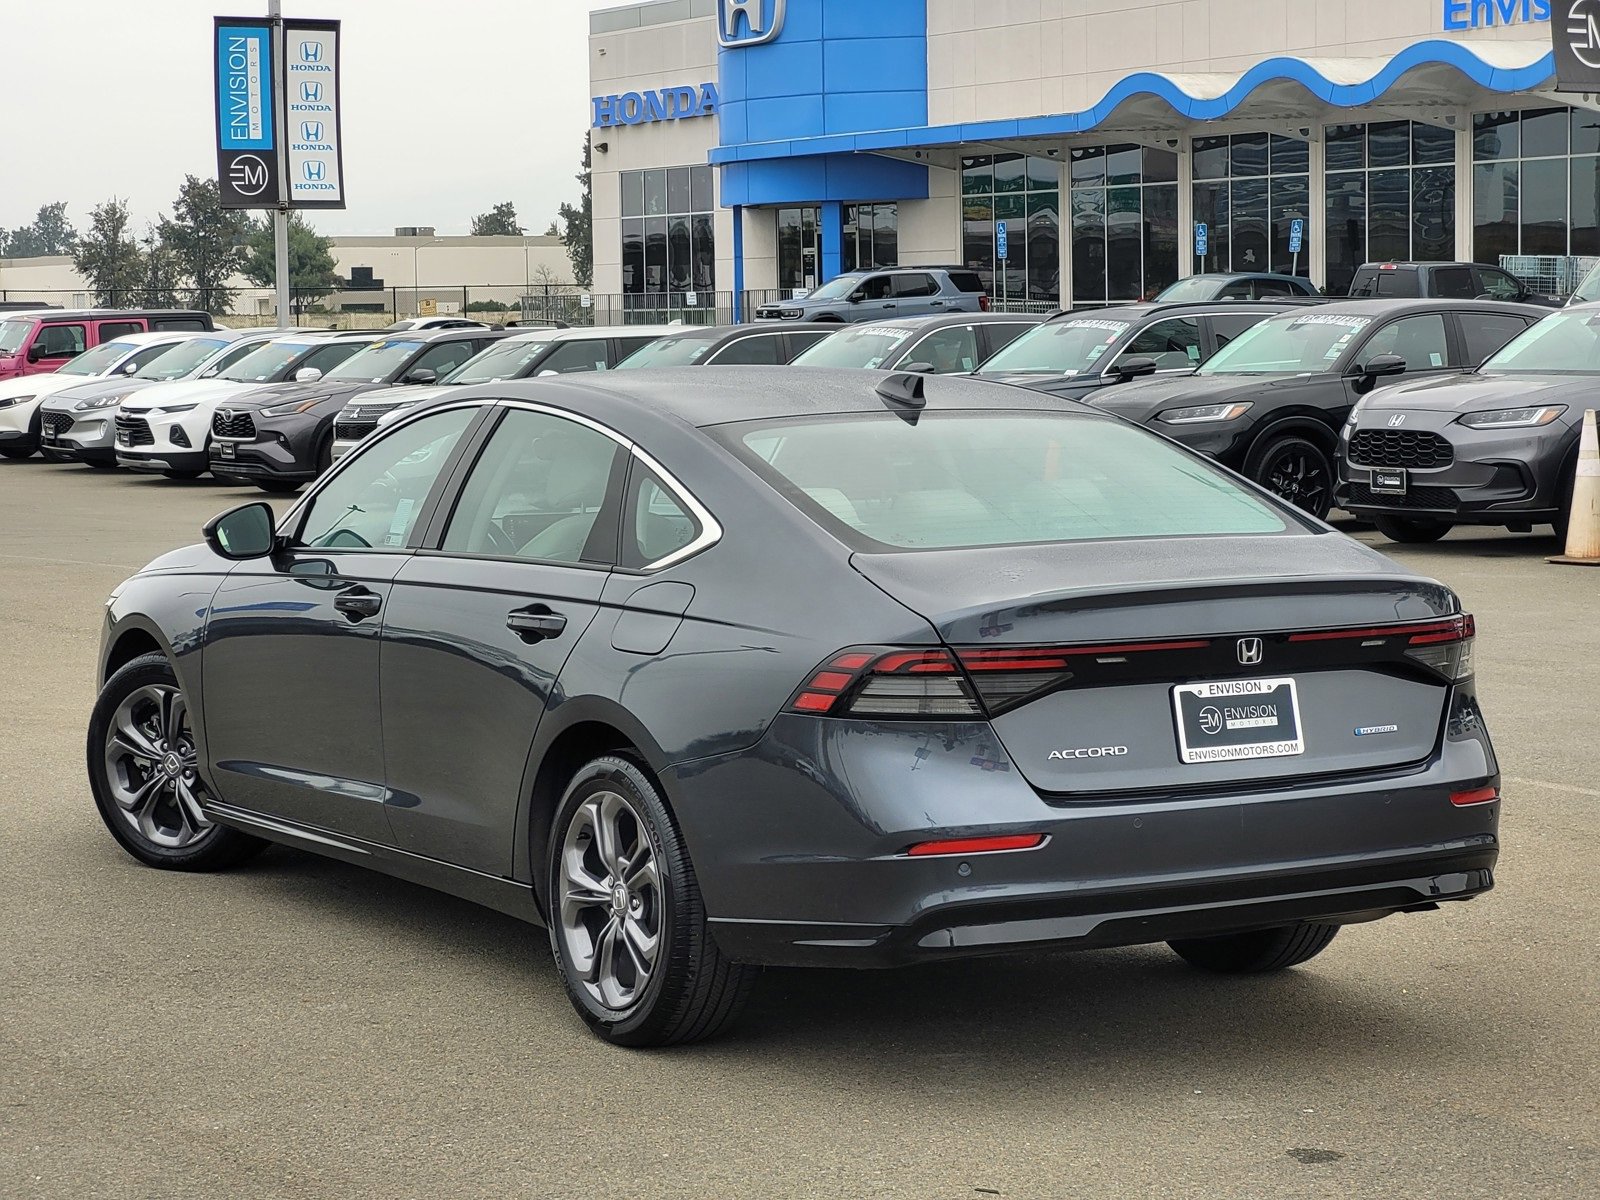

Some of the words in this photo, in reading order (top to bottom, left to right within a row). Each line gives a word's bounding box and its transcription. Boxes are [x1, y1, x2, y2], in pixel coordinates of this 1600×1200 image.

[290, 64, 332, 72] HONDA
[229, 37, 248, 140] ENVISION
[250, 47, 260, 131] MOTORS
[290, 104, 332, 112] HONDA
[591, 82, 719, 128] HONDA
[1209, 681, 1262, 695] ENVISION
[1224, 704, 1278, 720] ENVISION
[1231, 719, 1274, 727] MOTORS
[1362, 725, 1395, 734] HYBRID
[1047, 746, 1128, 760] ACCORD
[1188, 743, 1299, 761] ENVISIONMOTORS.COM
